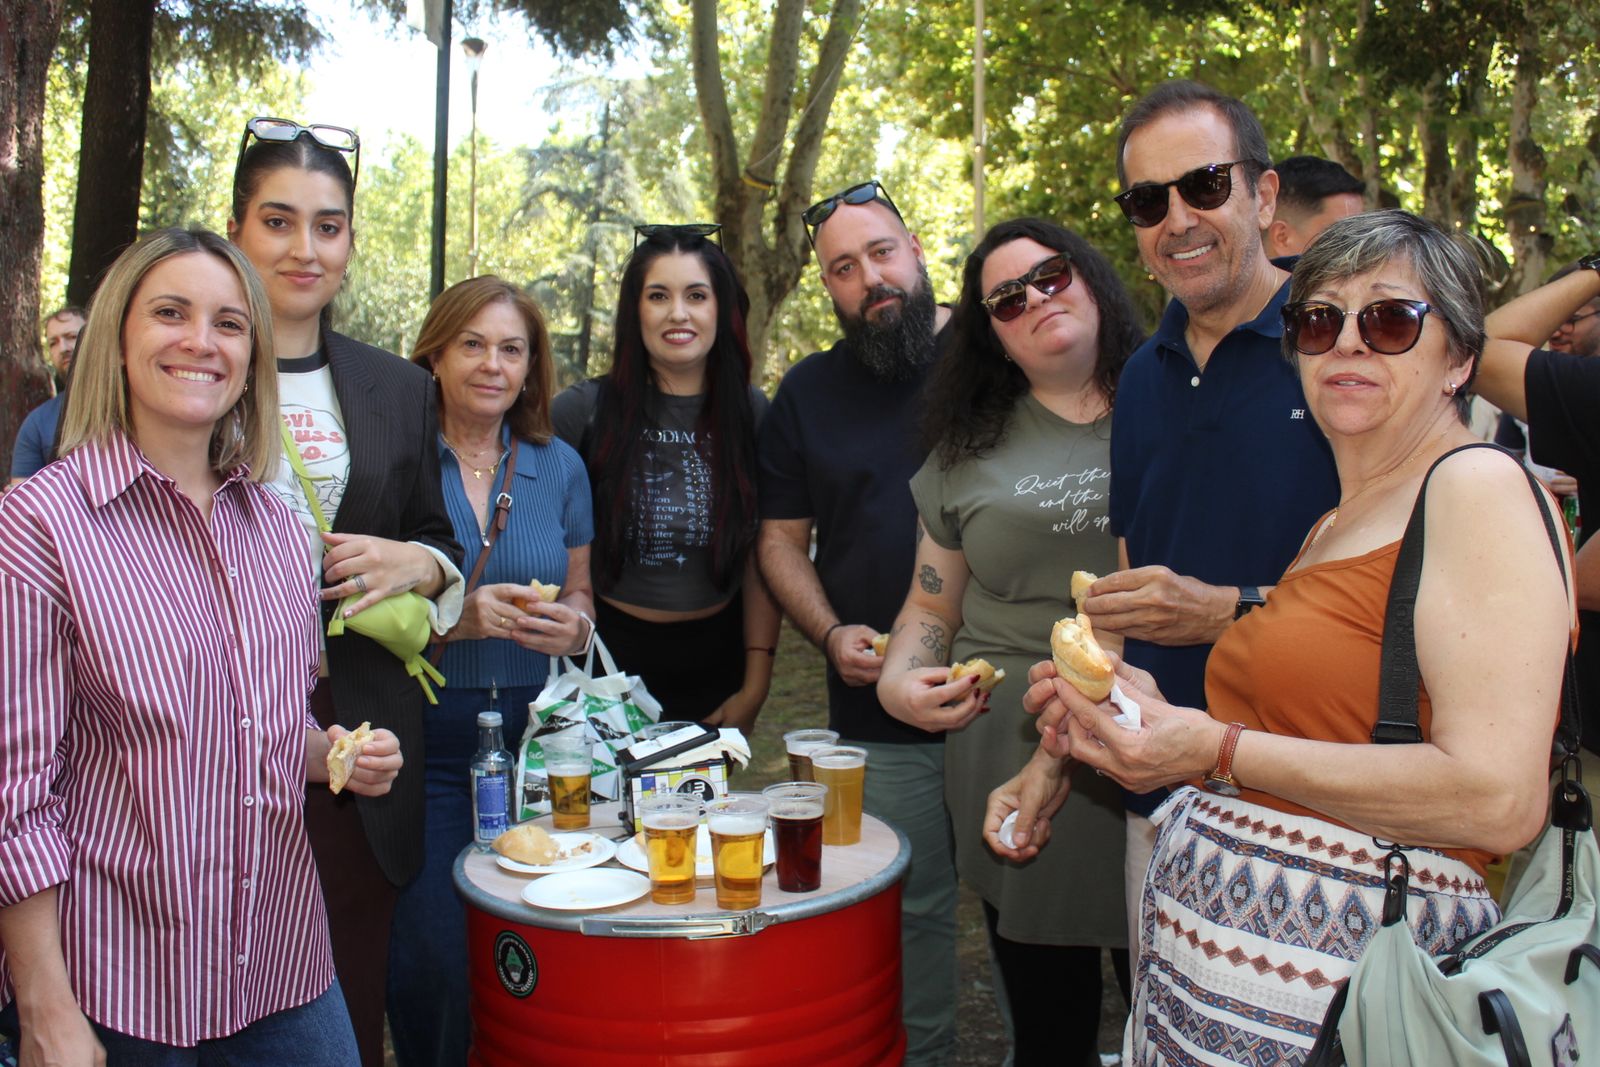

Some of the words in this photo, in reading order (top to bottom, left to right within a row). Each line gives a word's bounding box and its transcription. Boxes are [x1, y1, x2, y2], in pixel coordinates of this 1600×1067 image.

[1014, 474, 1067, 497] Quiet
[1068, 467, 1111, 485] the
[1039, 490, 1071, 511] and
[1070, 488, 1103, 506] the
[1053, 508, 1089, 534] will
